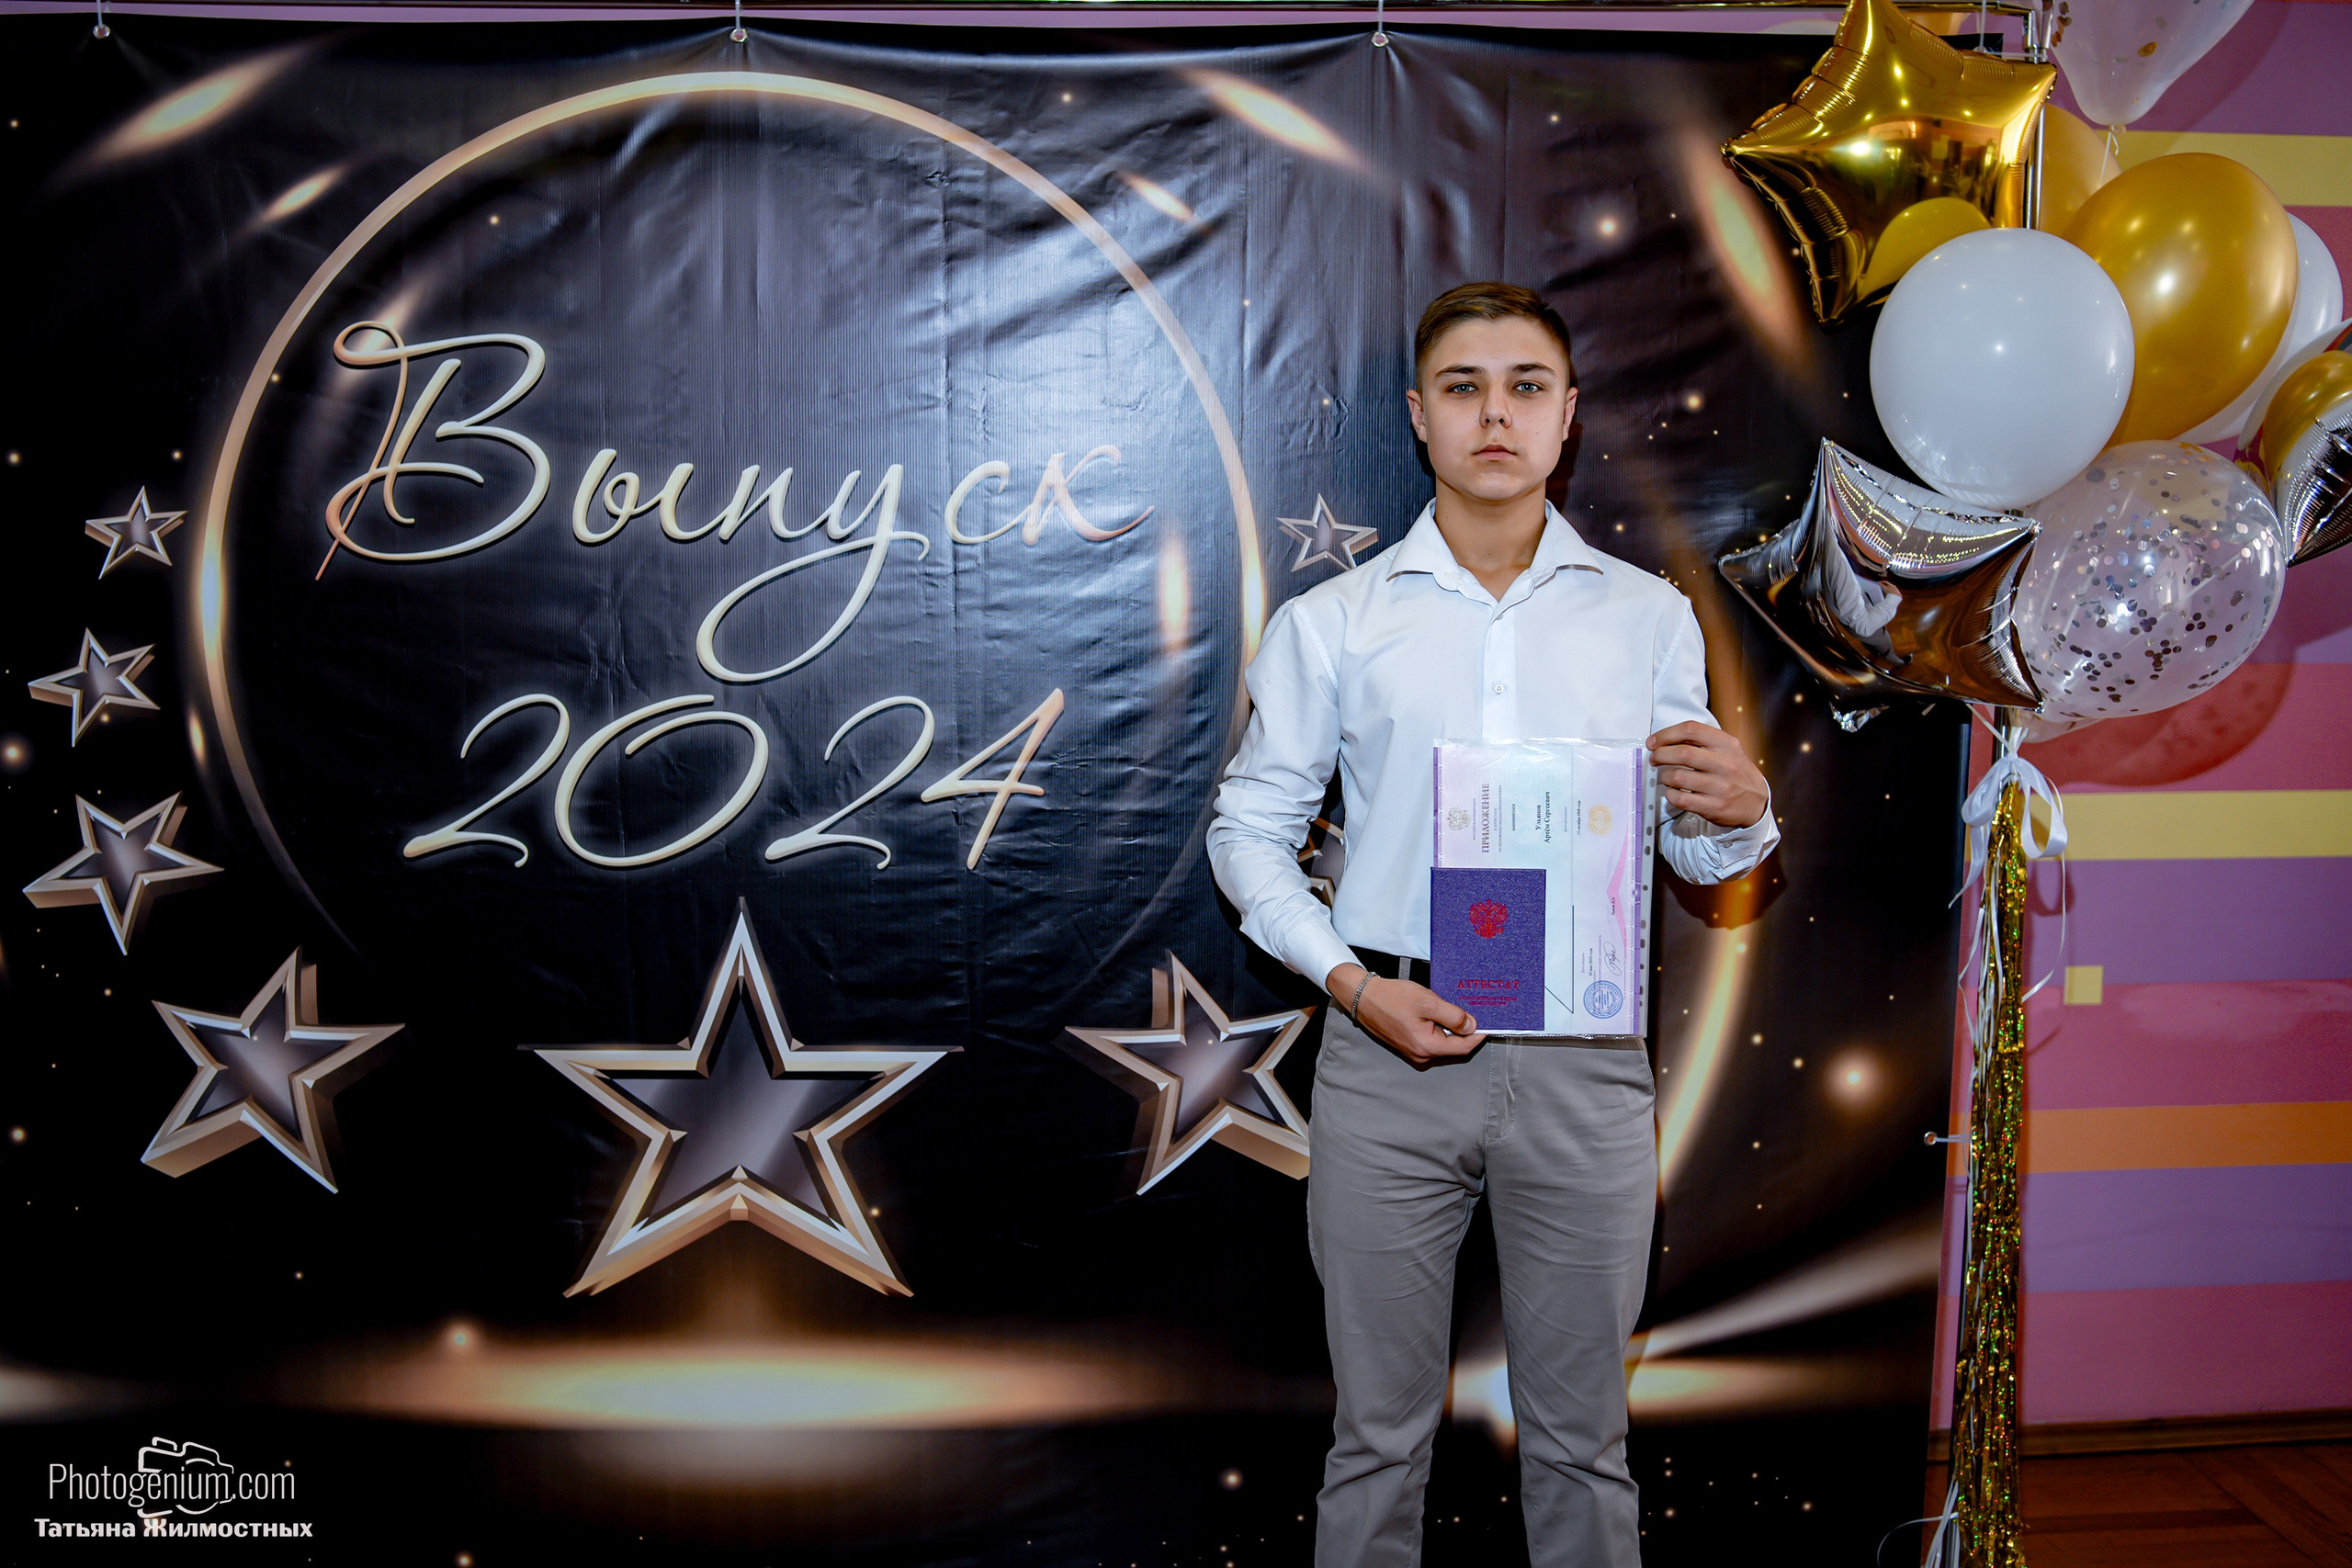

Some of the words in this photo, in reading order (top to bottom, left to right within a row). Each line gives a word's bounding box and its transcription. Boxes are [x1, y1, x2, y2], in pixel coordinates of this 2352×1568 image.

[315, 320, 1155, 682] Выпуск
[402, 687, 1065, 871] 2024
[1481, 783, 1490, 853] ПРИЛОЖЕНИЕ
[1457, 979, 1521, 989] АТТЕСТАТ
